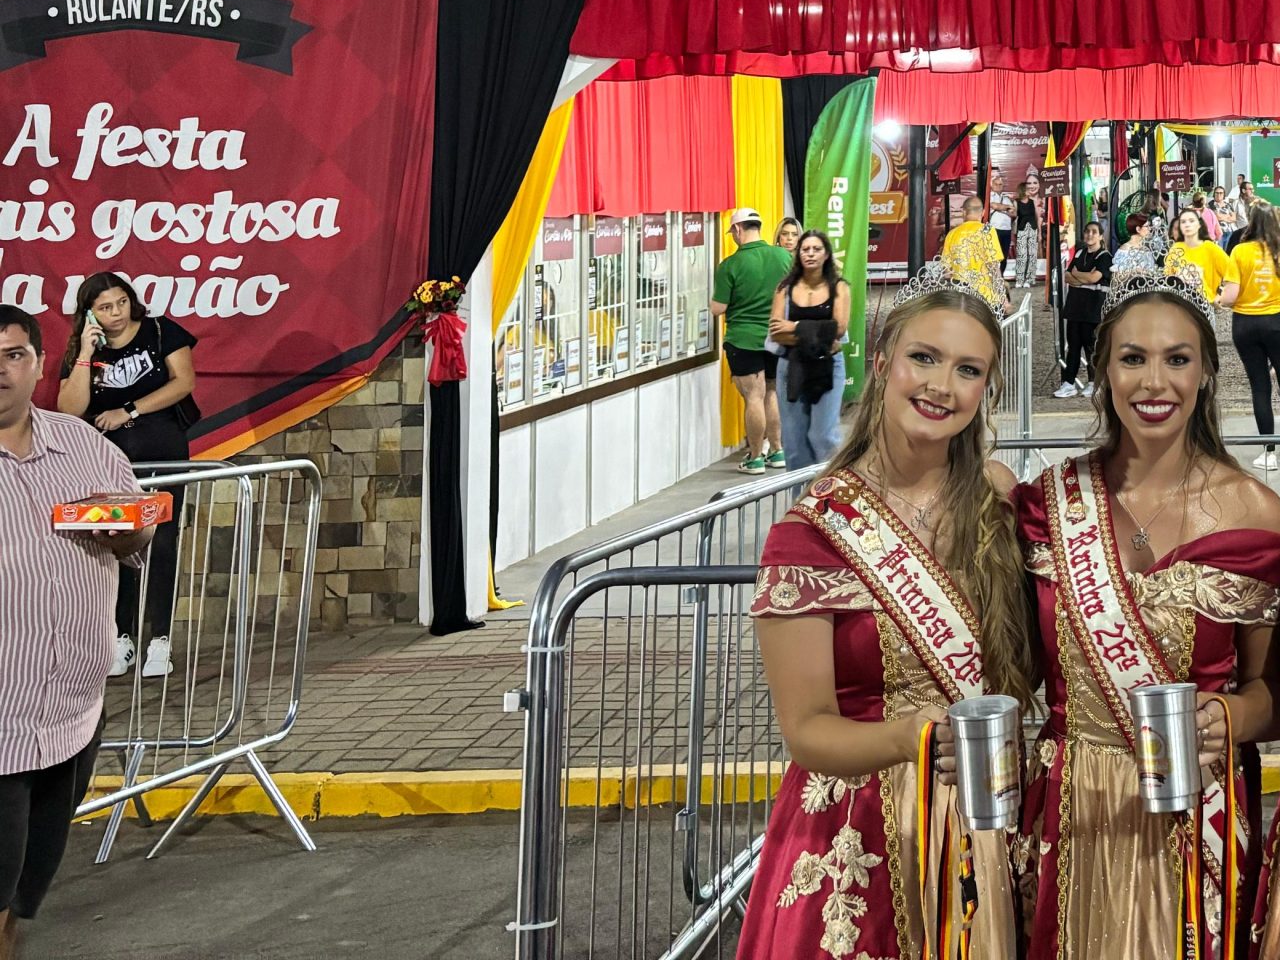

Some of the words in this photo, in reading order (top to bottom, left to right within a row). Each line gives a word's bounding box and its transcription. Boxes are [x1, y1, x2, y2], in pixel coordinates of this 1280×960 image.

[3, 104, 59, 168] A
[72, 102, 247, 180] festa
[0, 179, 76, 242] ais
[91, 190, 340, 259] gostosa
[0, 247, 49, 316] a
[62, 254, 290, 318] rgião
[98, 349, 154, 389] REAM
[874, 543, 956, 649] Princesa
[1067, 524, 1110, 619] Rainha
